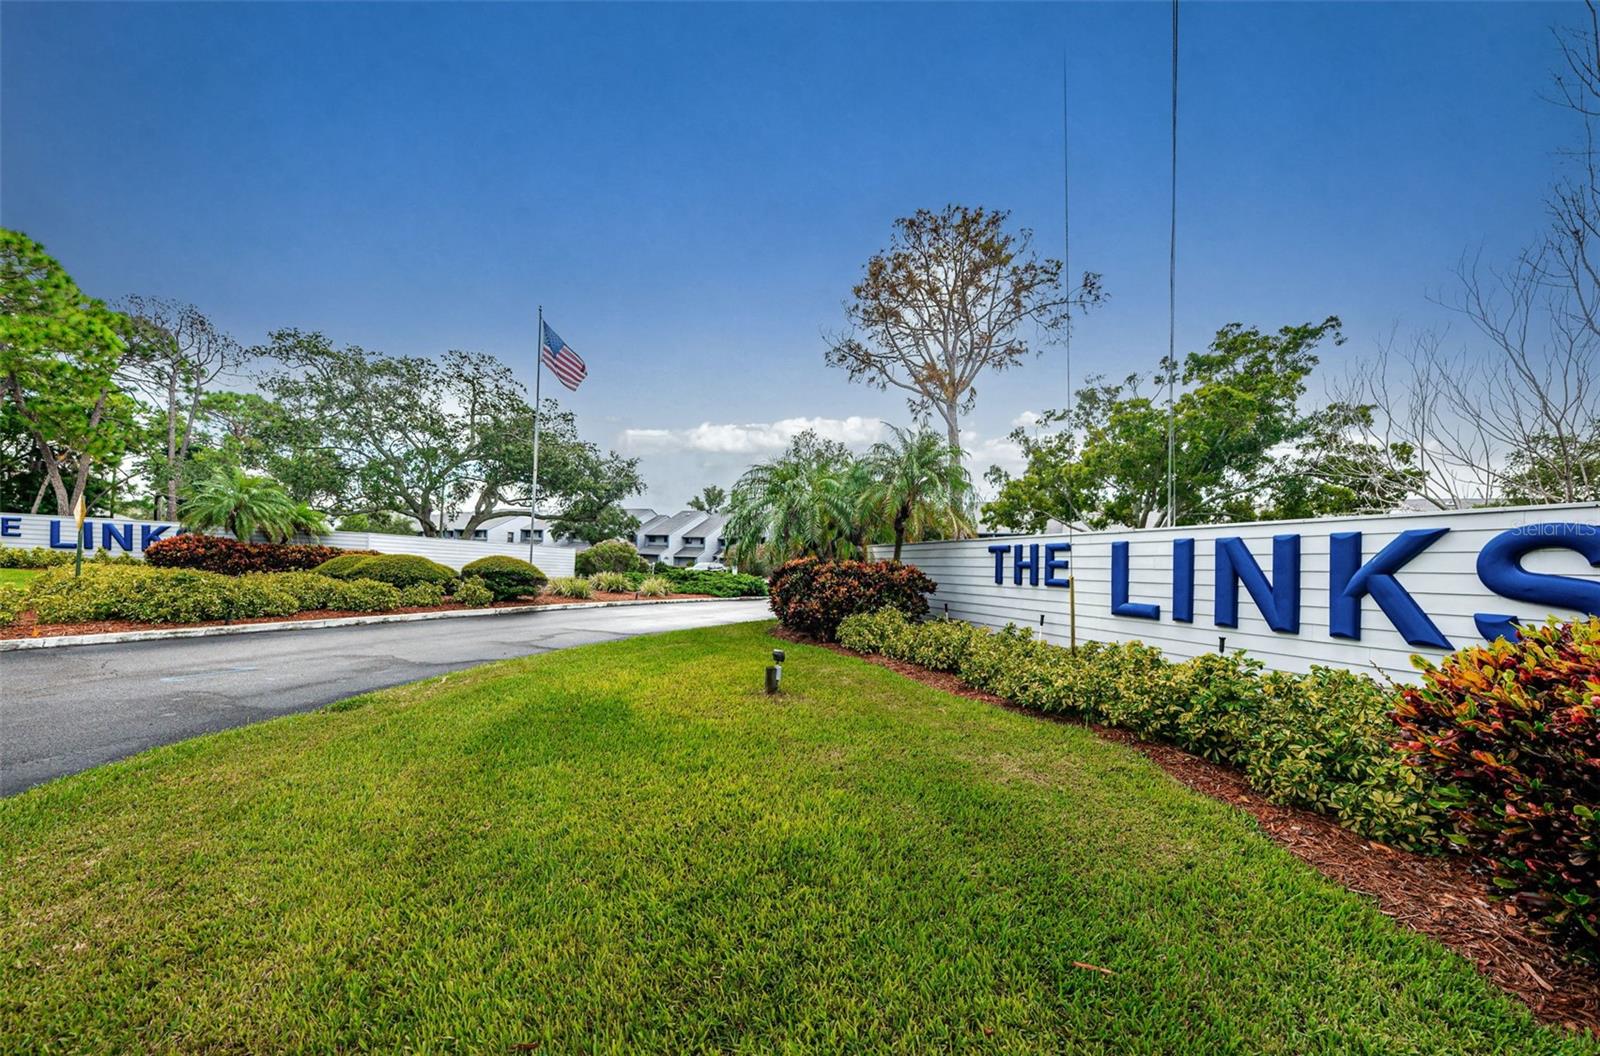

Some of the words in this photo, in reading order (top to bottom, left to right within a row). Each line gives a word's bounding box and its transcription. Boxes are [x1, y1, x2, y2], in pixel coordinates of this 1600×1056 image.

[50, 520, 189, 551] LINK
[988, 543, 1071, 588] THE
[1111, 523, 1600, 651] LINKS
